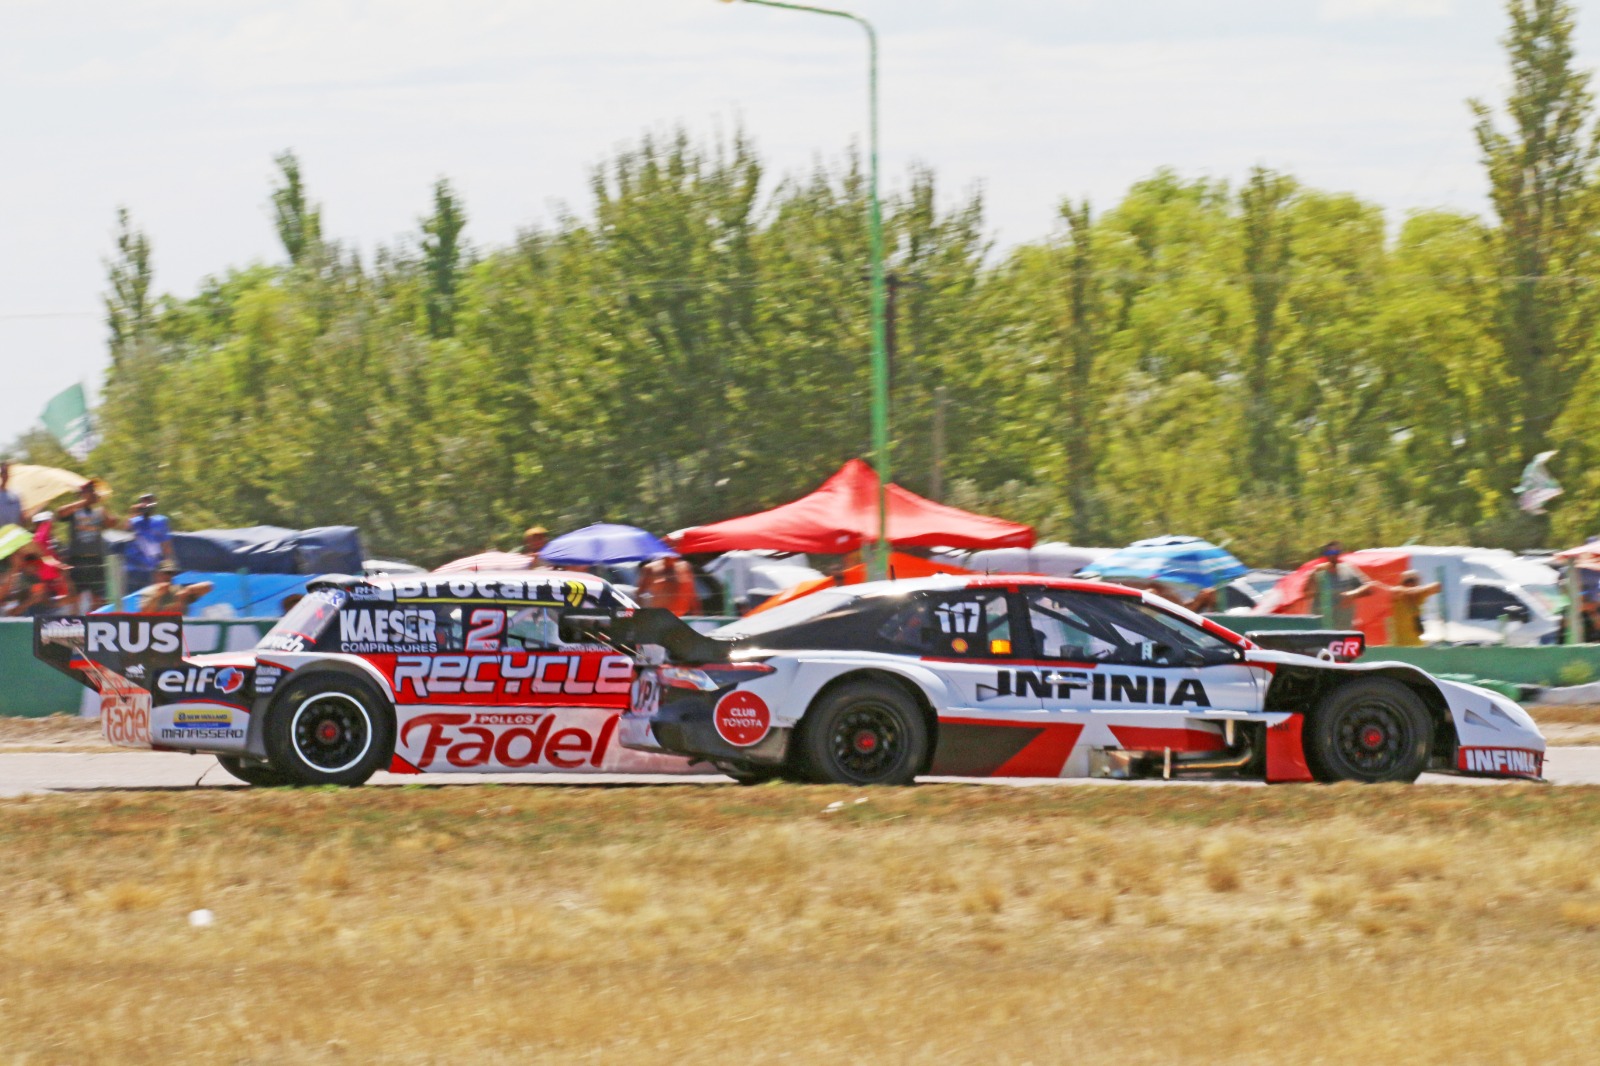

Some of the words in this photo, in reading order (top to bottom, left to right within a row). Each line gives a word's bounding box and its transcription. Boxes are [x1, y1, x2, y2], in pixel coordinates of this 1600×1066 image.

[340, 608, 437, 643] KAESER
[464, 608, 505, 652] 2
[934, 602, 980, 634] 117
[87, 621, 180, 653] RUS
[341, 642, 438, 653] COMPRESORES
[1328, 640, 1360, 657] GR
[157, 667, 216, 693] elf
[995, 669, 1212, 708] INFINIA
[479, 713, 535, 725] POLLOS
[722, 718, 764, 728] TOYOTA
[730, 707, 757, 718] CLUB
[401, 712, 621, 769] Fadel
